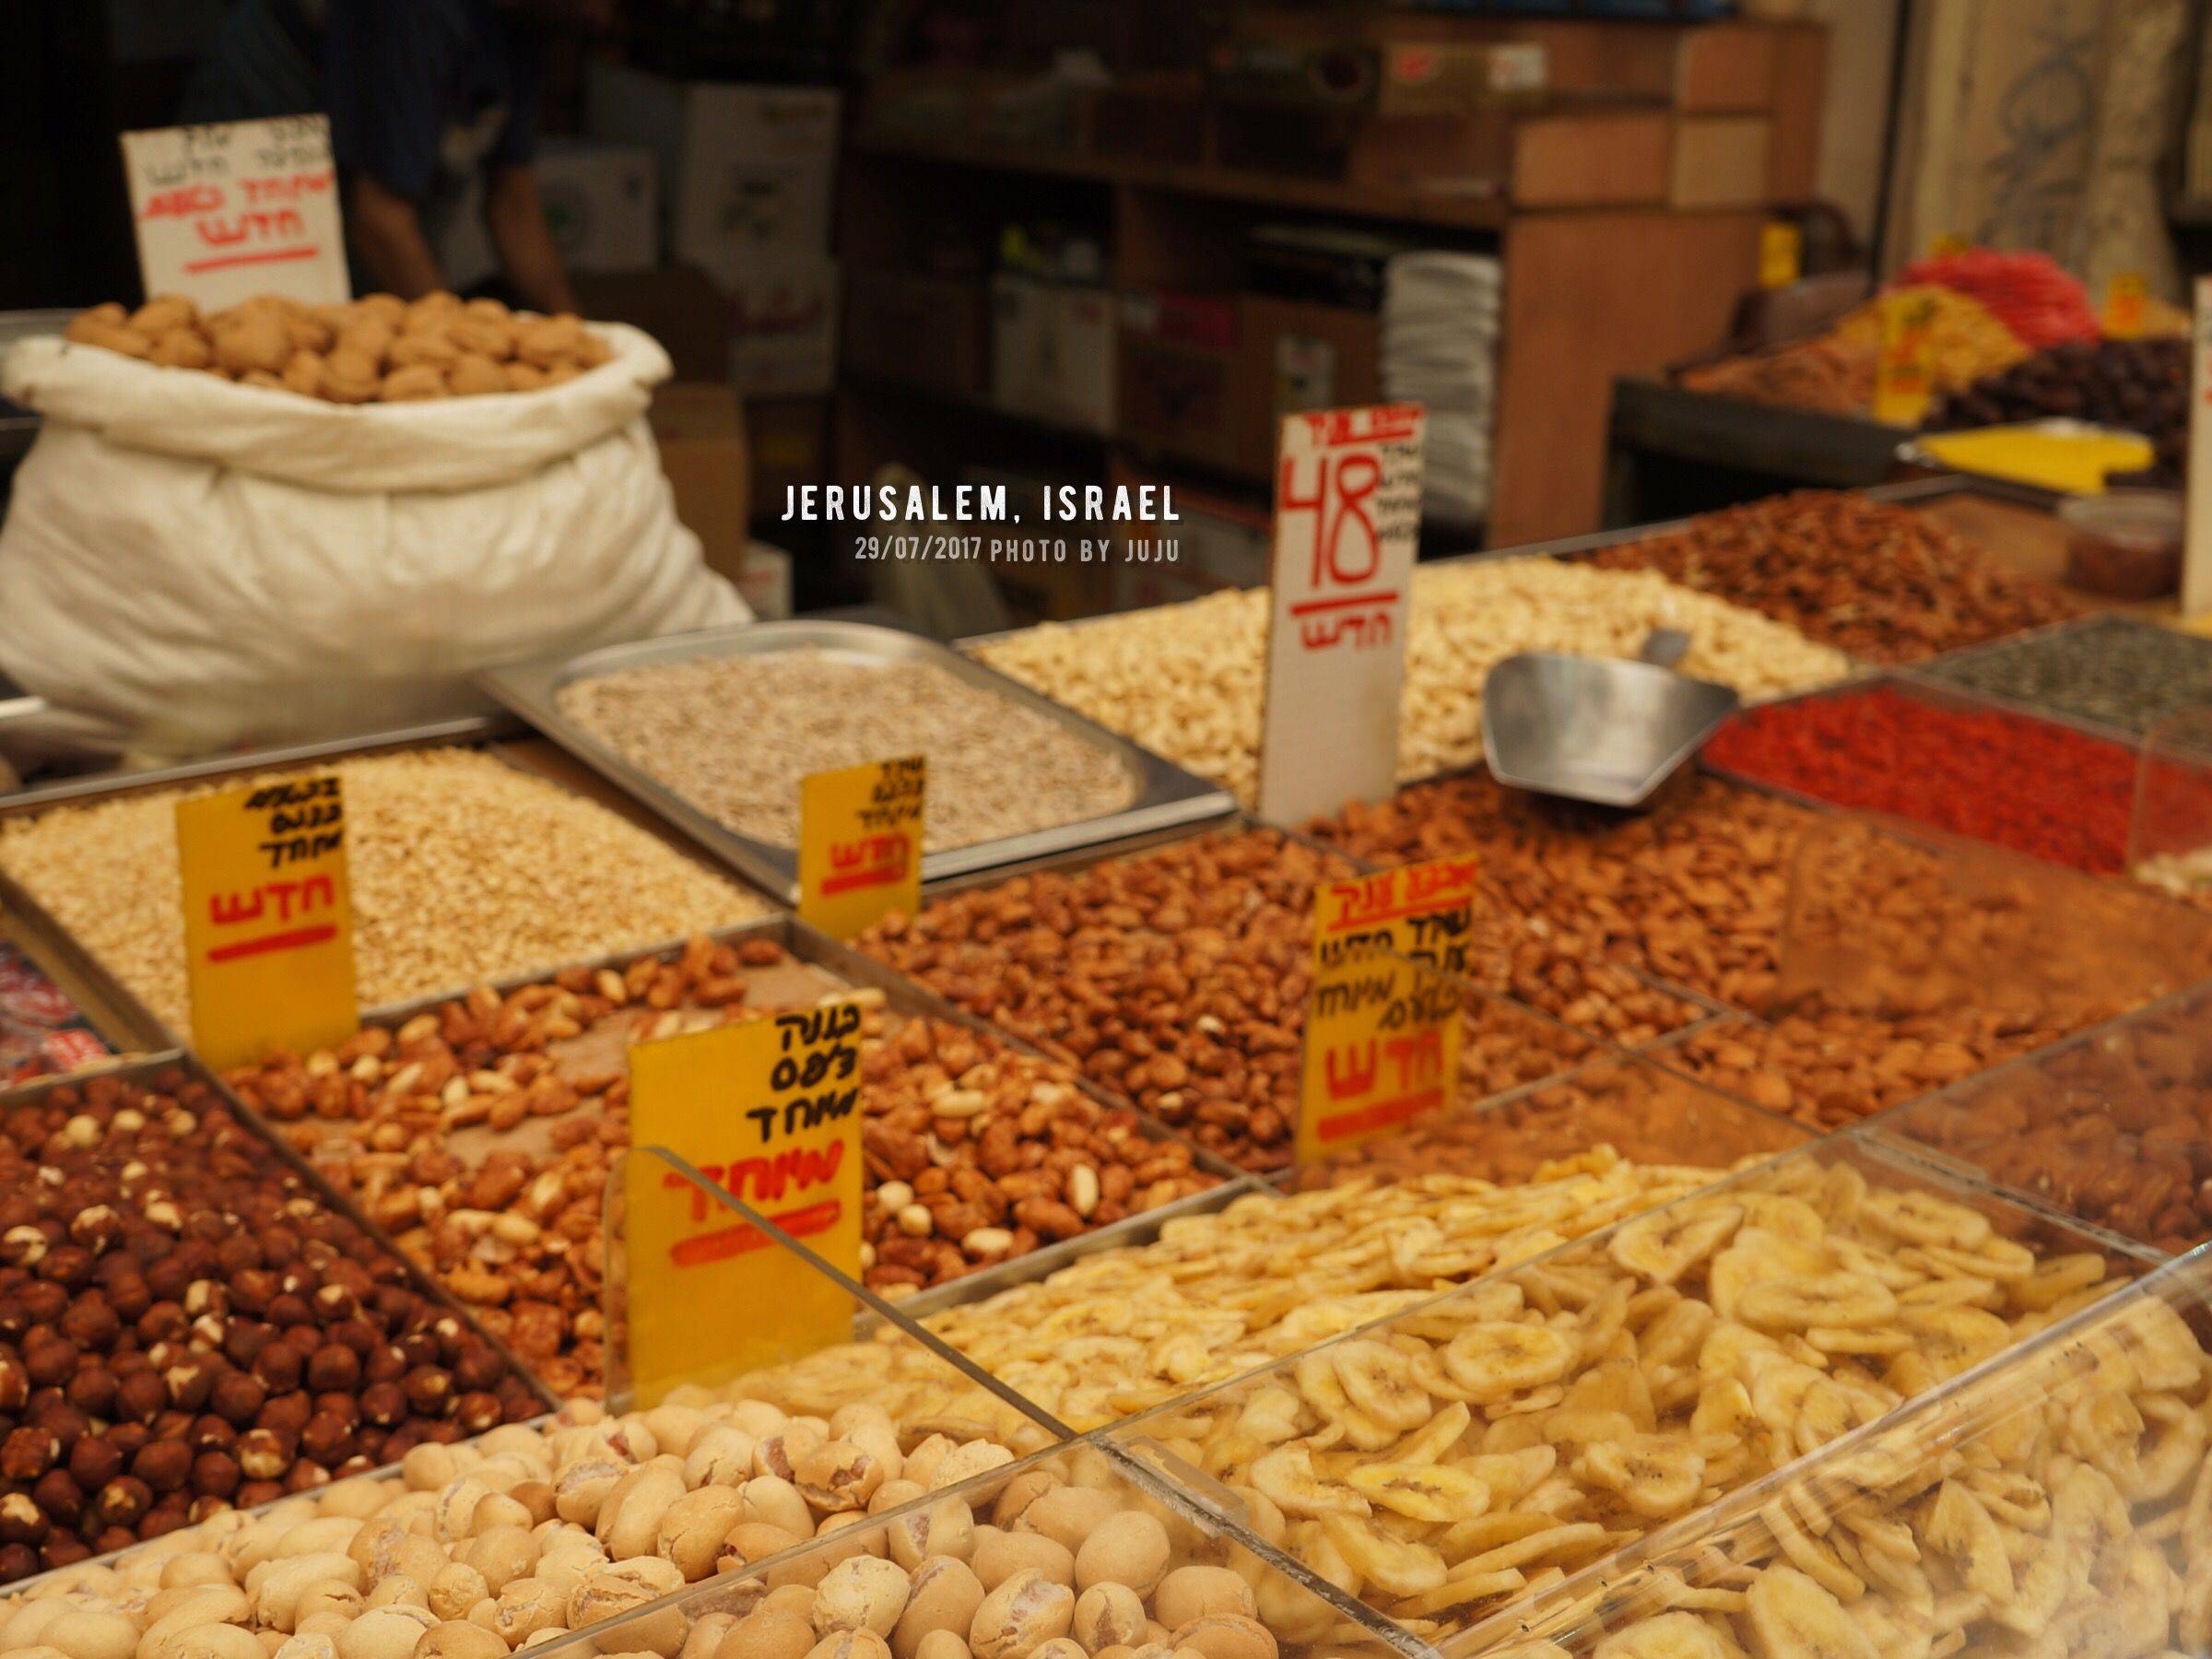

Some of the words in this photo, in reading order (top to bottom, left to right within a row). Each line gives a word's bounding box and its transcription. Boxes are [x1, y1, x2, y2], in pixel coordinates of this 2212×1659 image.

[194, 210, 306, 246] חדש
[1278, 452, 1382, 590] 48
[1300, 613, 1392, 651] חדש
[208, 875, 335, 924] חדש
[1325, 1028, 1444, 1100] חדש
